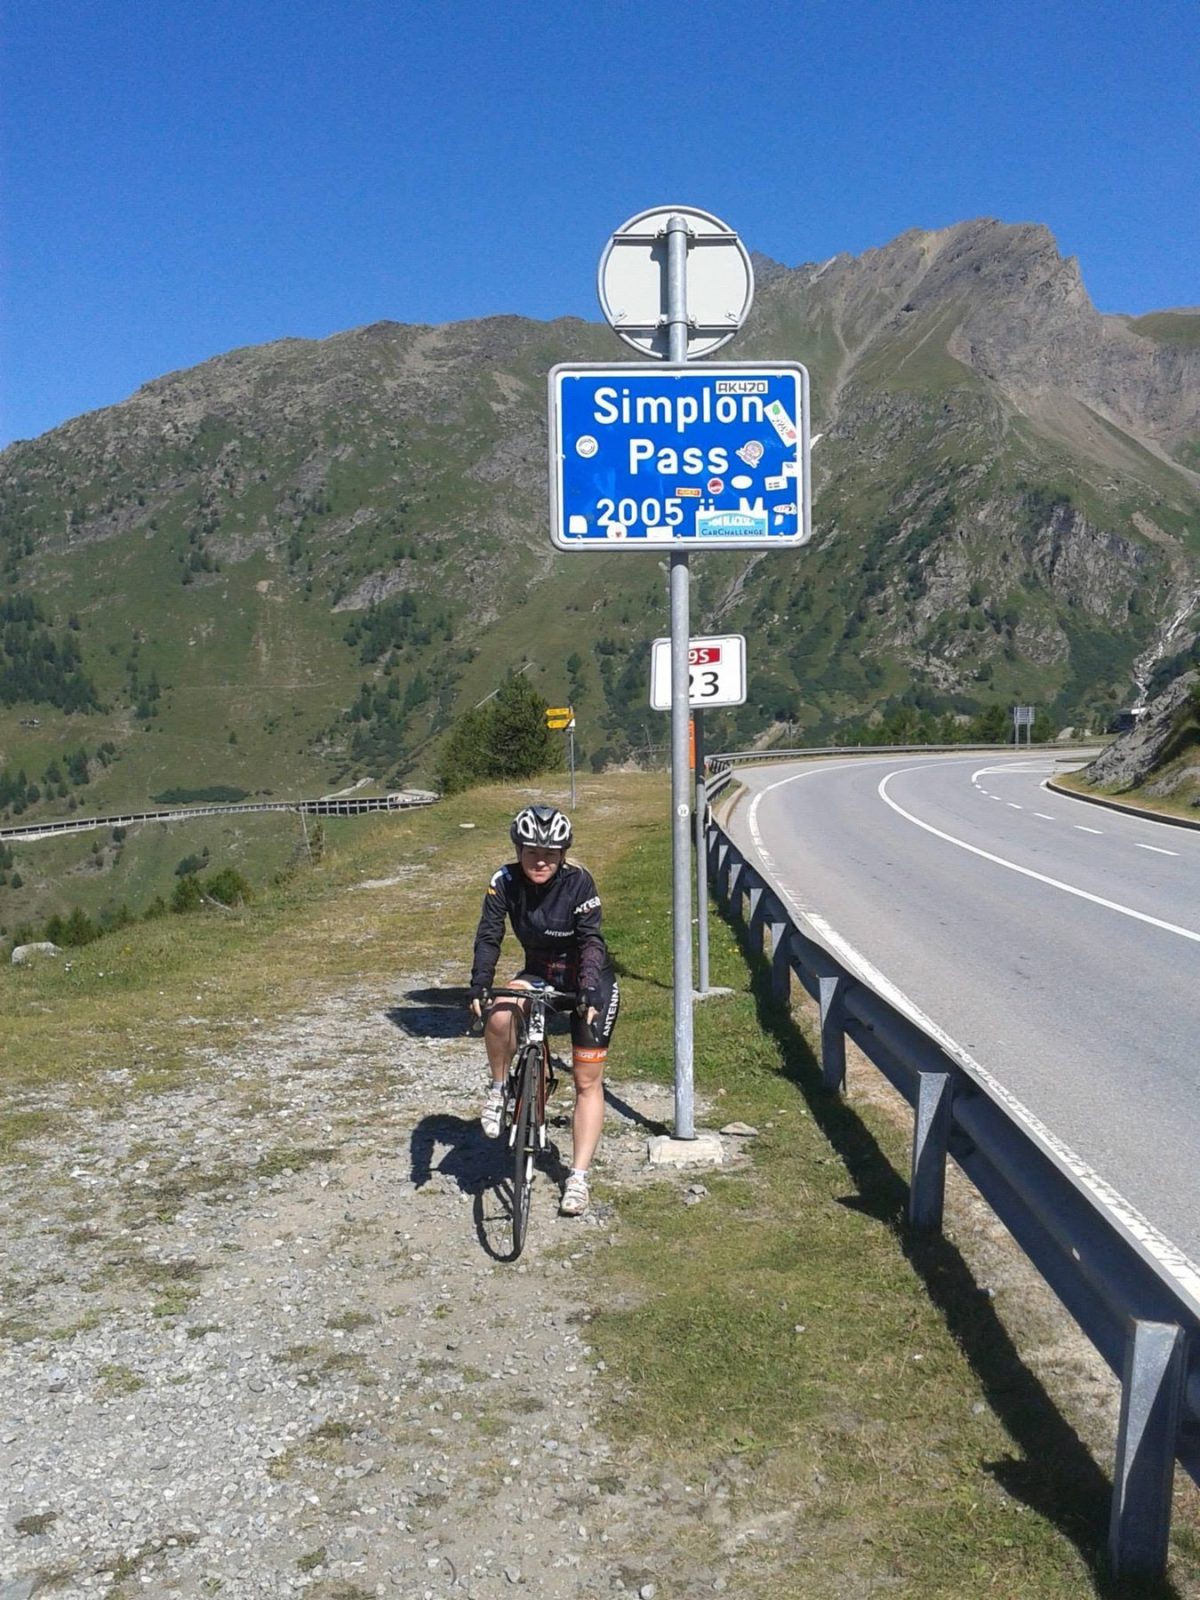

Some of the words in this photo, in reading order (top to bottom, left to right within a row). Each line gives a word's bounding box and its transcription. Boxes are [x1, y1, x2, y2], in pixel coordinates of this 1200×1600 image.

[593, 386, 764, 433] Simplon
[629, 438, 729, 475] Pass
[596, 497, 684, 526] 2005
[602, 981, 620, 1037] ANTENNA
